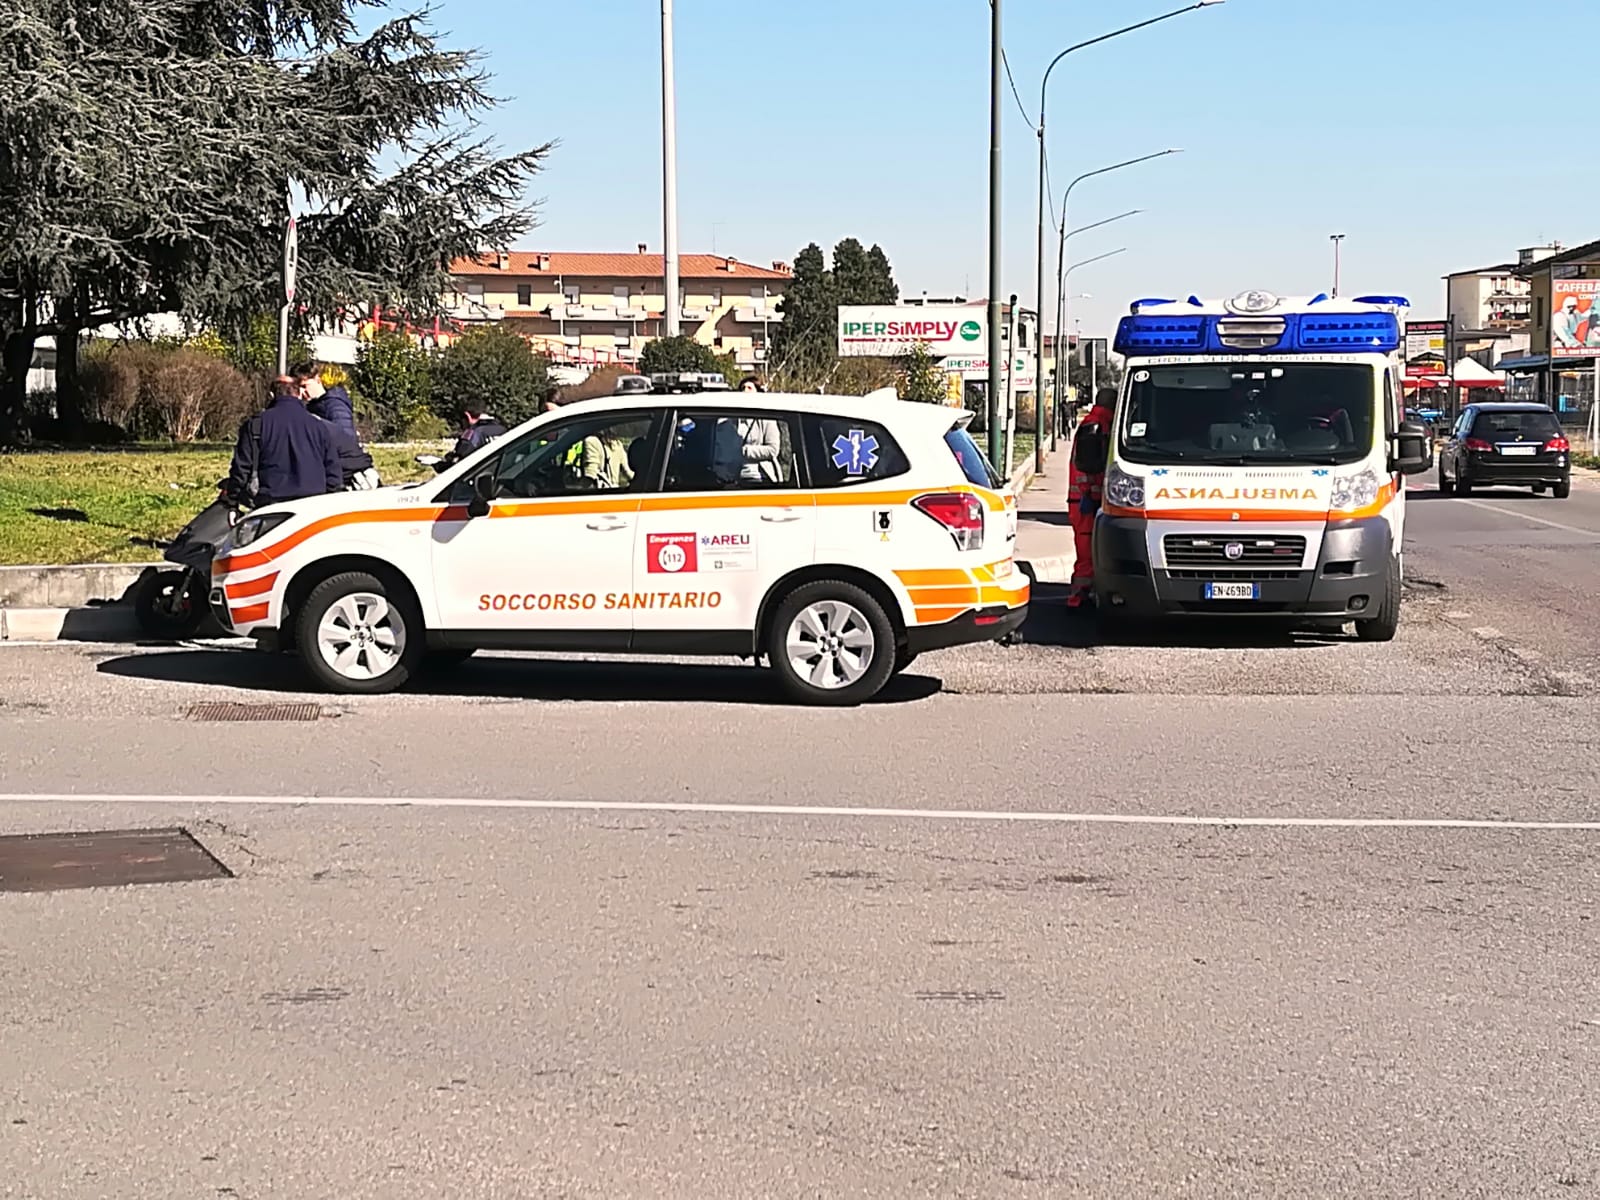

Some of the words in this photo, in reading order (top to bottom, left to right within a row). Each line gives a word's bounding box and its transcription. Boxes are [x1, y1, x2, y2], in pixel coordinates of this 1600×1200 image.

[649, 534, 695, 545] Emergenza
[710, 534, 750, 546] AREU
[667, 553, 682, 563] 112
[478, 592, 597, 611] SOCCORSO
[603, 590, 722, 610] SANITARIO
